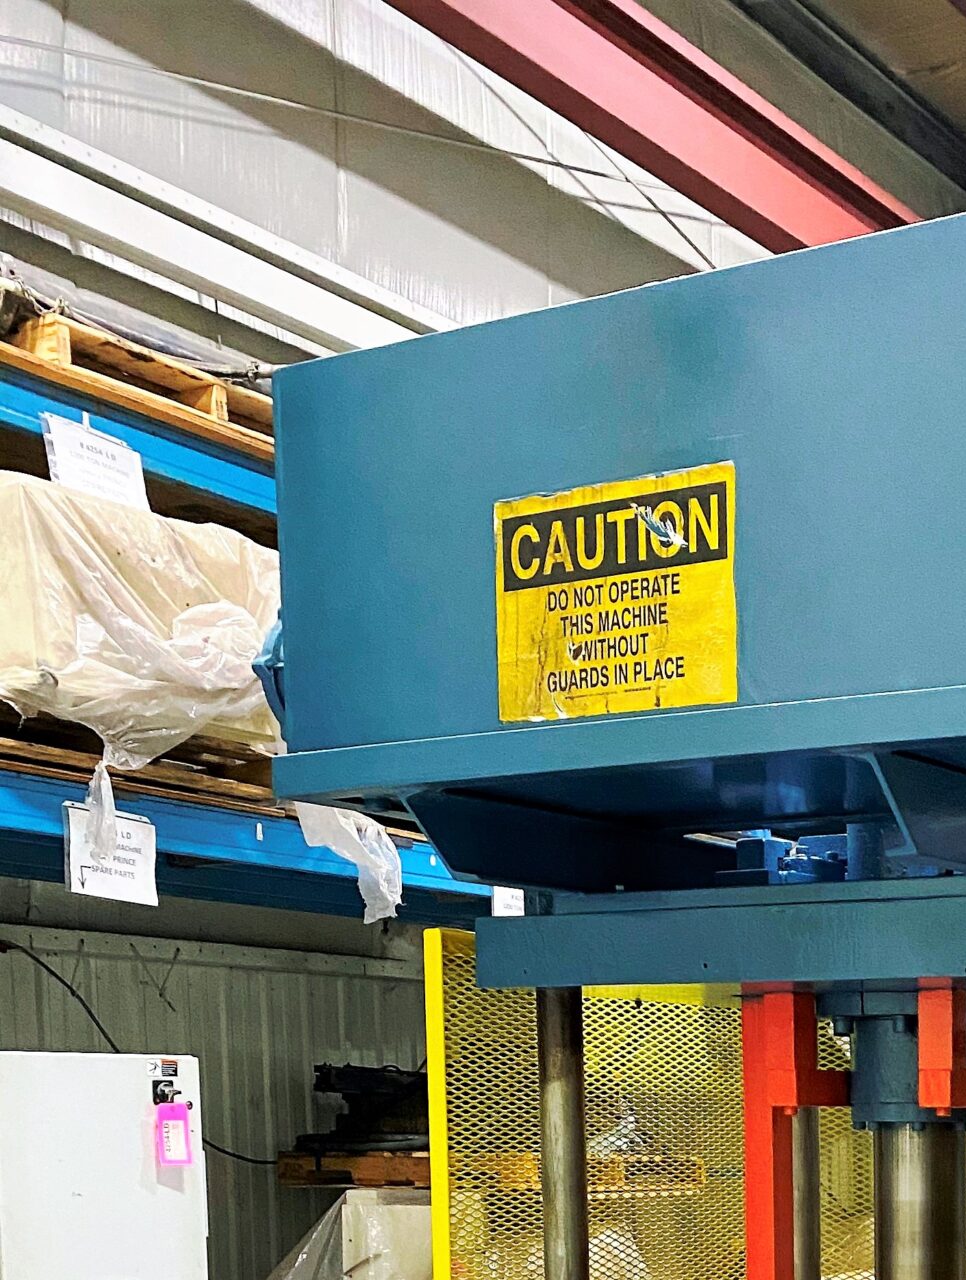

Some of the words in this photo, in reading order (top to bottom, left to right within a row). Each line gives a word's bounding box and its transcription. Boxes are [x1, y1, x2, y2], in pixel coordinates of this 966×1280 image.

[510, 494, 719, 580] CAUTION
[548, 590, 569, 612] DO
[574, 584, 604, 609] NOT
[608, 573, 681, 604] OPERATE
[560, 613, 593, 637] THIS
[599, 602, 668, 632] MACHINE
[581, 633, 649, 661] WITHOUT
[547, 665, 609, 693] GUARDS
[614, 663, 628, 684] IN
[633, 656, 685, 682] PLACE
[91, 865, 113, 876] SPARE
[114, 870, 136, 880] PARTS
[113, 855, 136, 866] PRINCE
